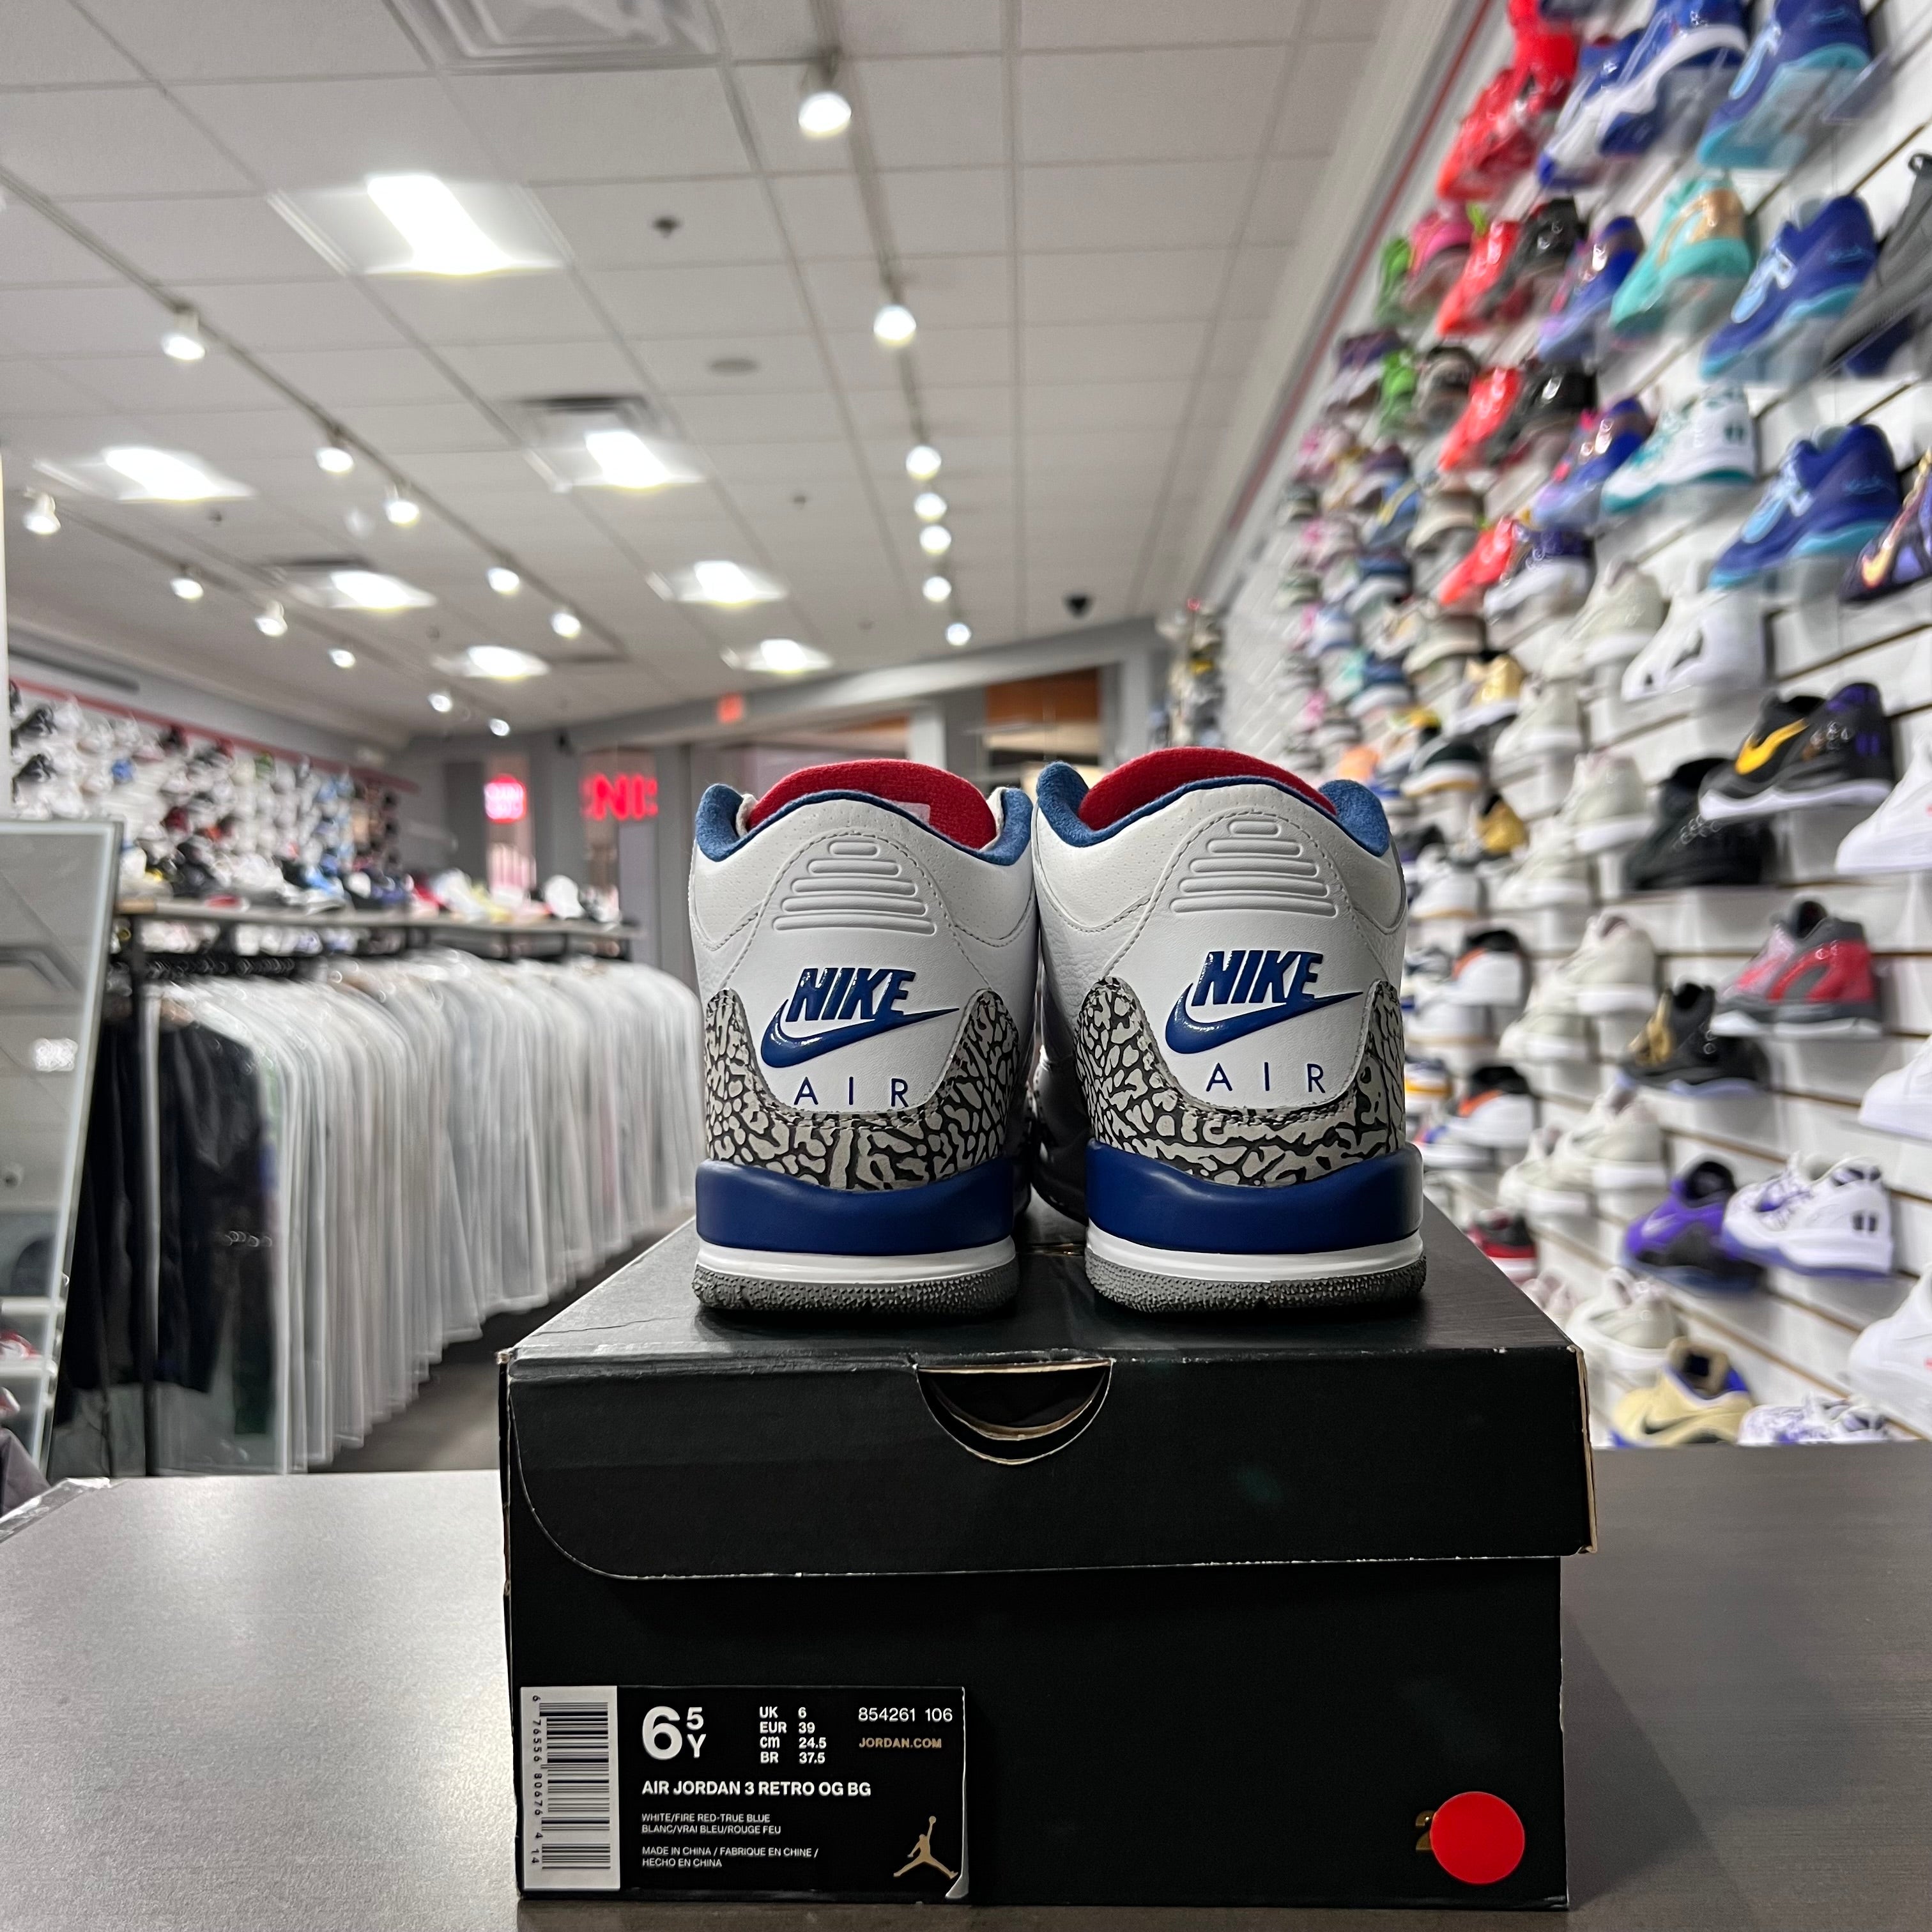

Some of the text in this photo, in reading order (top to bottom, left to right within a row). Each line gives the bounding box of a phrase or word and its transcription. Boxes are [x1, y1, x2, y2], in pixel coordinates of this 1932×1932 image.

[1191, 949, 1324, 1007] NIKE
[785, 967, 916, 1023] NIKE
[1206, 1061, 1326, 1094] AIR
[793, 1076, 908, 1107] AIR
[759, 1706, 807, 1719] UK 6
[858, 1707, 953, 1722] 854261 106
[760, 1721, 815, 1734] EUR 39
[533, 1719, 542, 1762] 76556
[799, 1736, 827, 1749] 24.5
[859, 1737, 942, 1749] JORDAN.COM
[760, 1751, 825, 1764] BR 37.5
[534, 1772, 543, 1816] 80676
[641, 1780, 871, 1797] AIR JORDAN 3 RETRO OG BG
[641, 1813, 770, 1823] WHITE/FIRE RED-TRUE BLUE
[641, 1825, 781, 1834] BLANC/VRAI BLEU/ROUGE FEU
[642, 1846, 669, 1855] MADE
[671, 1846, 680, 1856] IN
[682, 1846, 712, 1856] CHINA
[719, 1847, 766, 1857] FABRIQUE
[768, 1848, 781, 1857] EN
[783, 1848, 812, 1857] CHINE
[642, 1858, 723, 1868] HECHO EN CHINA
